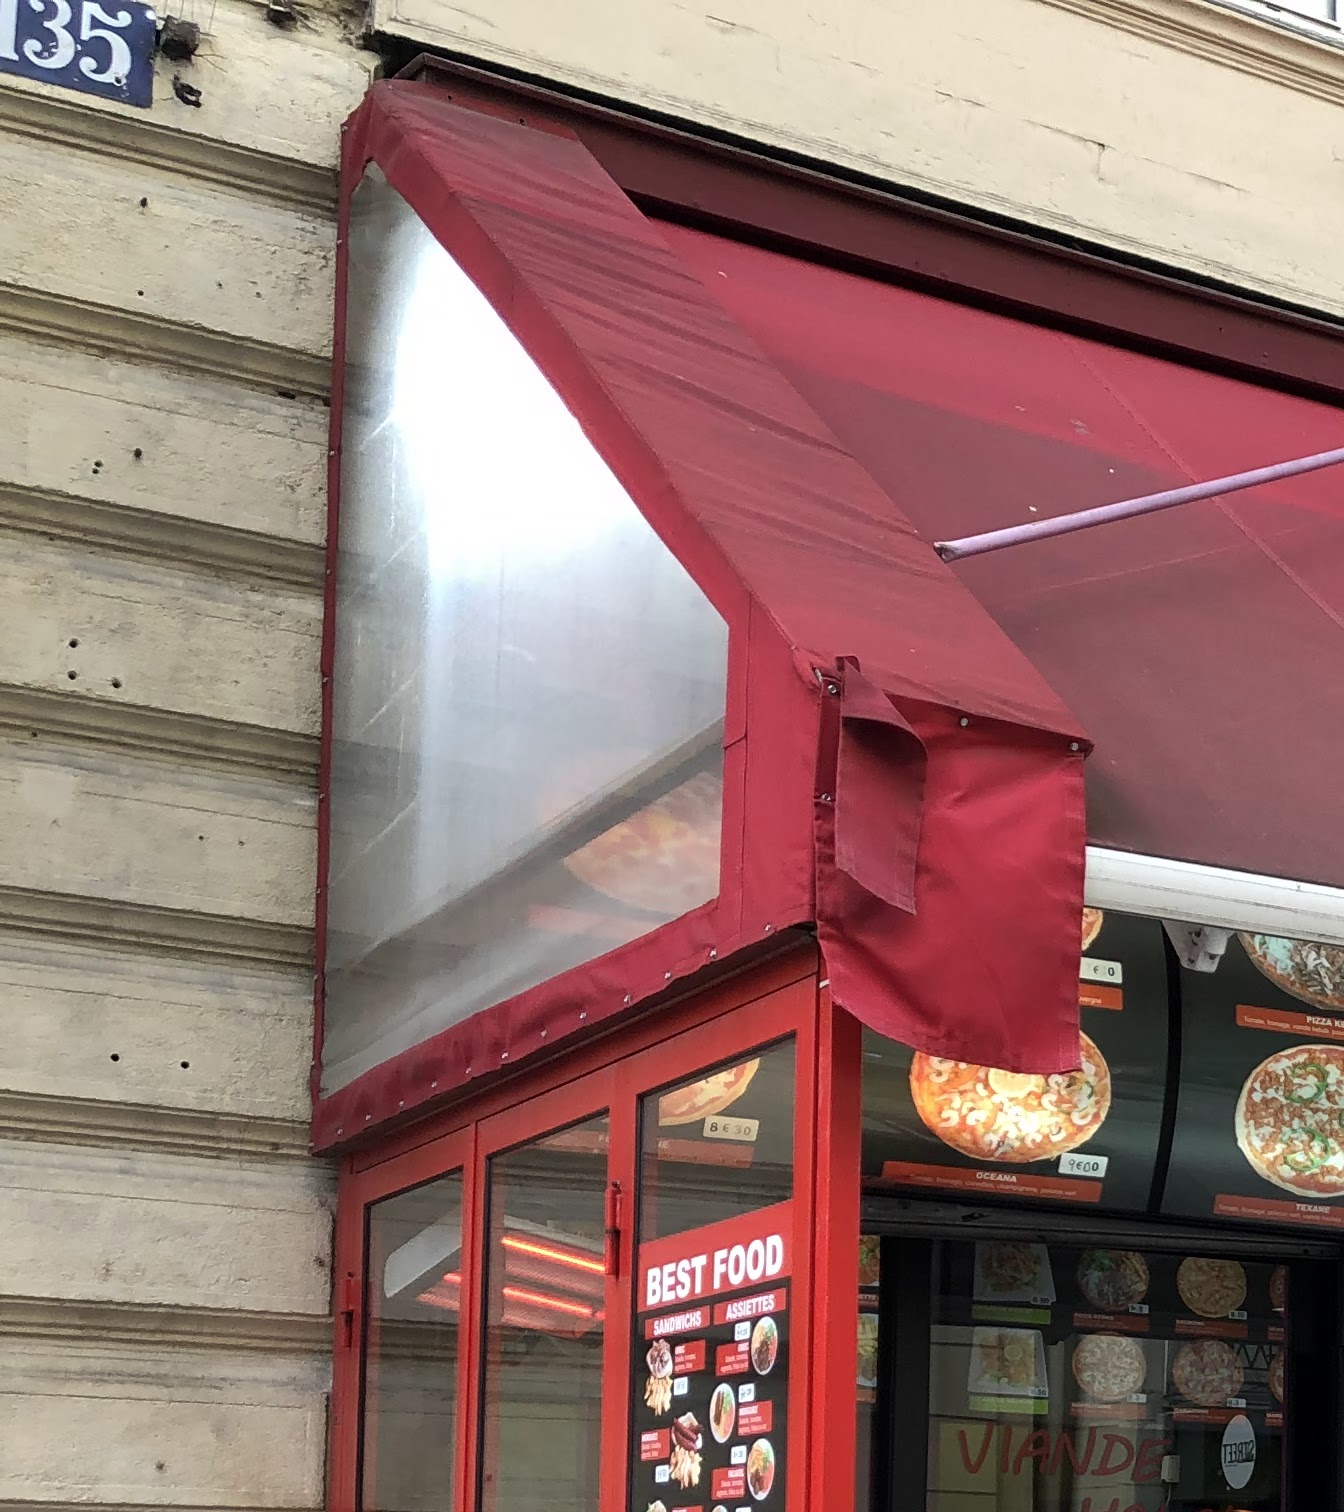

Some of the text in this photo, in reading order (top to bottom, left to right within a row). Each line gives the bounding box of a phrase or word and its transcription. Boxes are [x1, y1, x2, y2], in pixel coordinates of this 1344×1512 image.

[1306, 1015, 1333, 1027] PIZZA
[975, 1171, 1017, 1183] OCEANA
[646, 1234, 783, 1306] BEST FOOD
[653, 1294, 775, 1336] SANDWICHS ASSIETTES
[958, 1422, 1172, 1482] VIANDE
